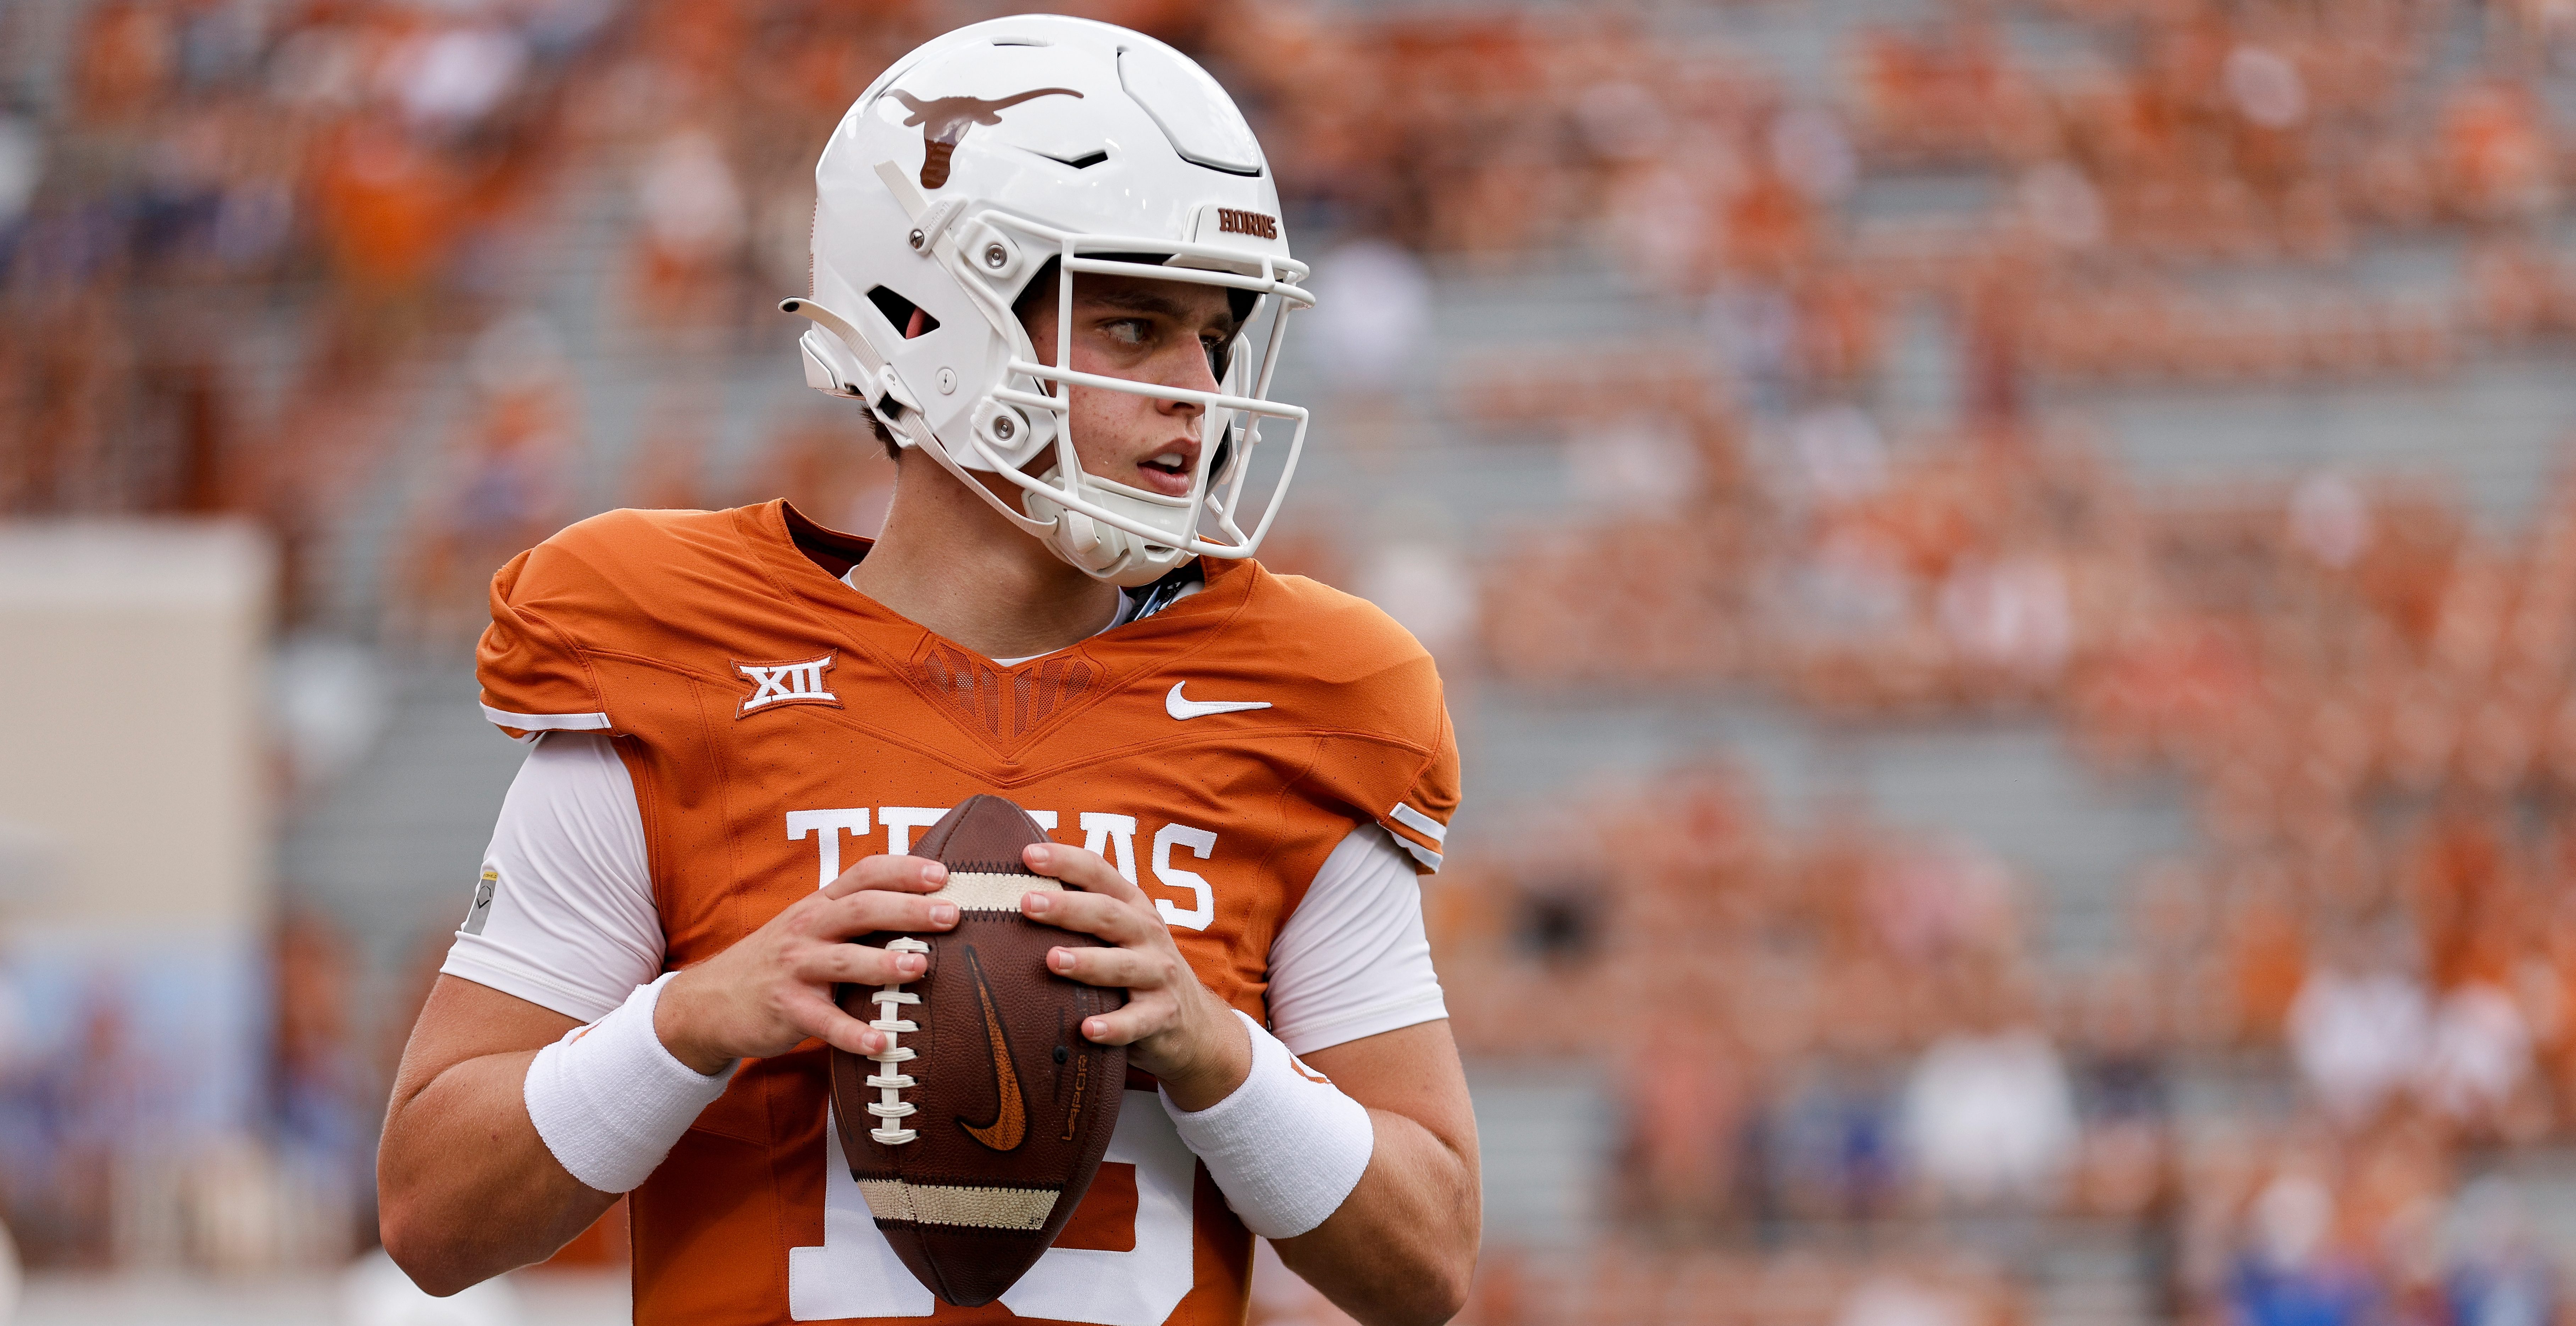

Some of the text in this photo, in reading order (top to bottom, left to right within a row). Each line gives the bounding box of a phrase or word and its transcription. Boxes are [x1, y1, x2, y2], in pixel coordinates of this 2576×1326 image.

[923, 201, 950, 234] Riddell
[1217, 207, 1277, 240] HORNS
[739, 656, 836, 710] XII
[1062, 1054, 1088, 1141] VAPOR
